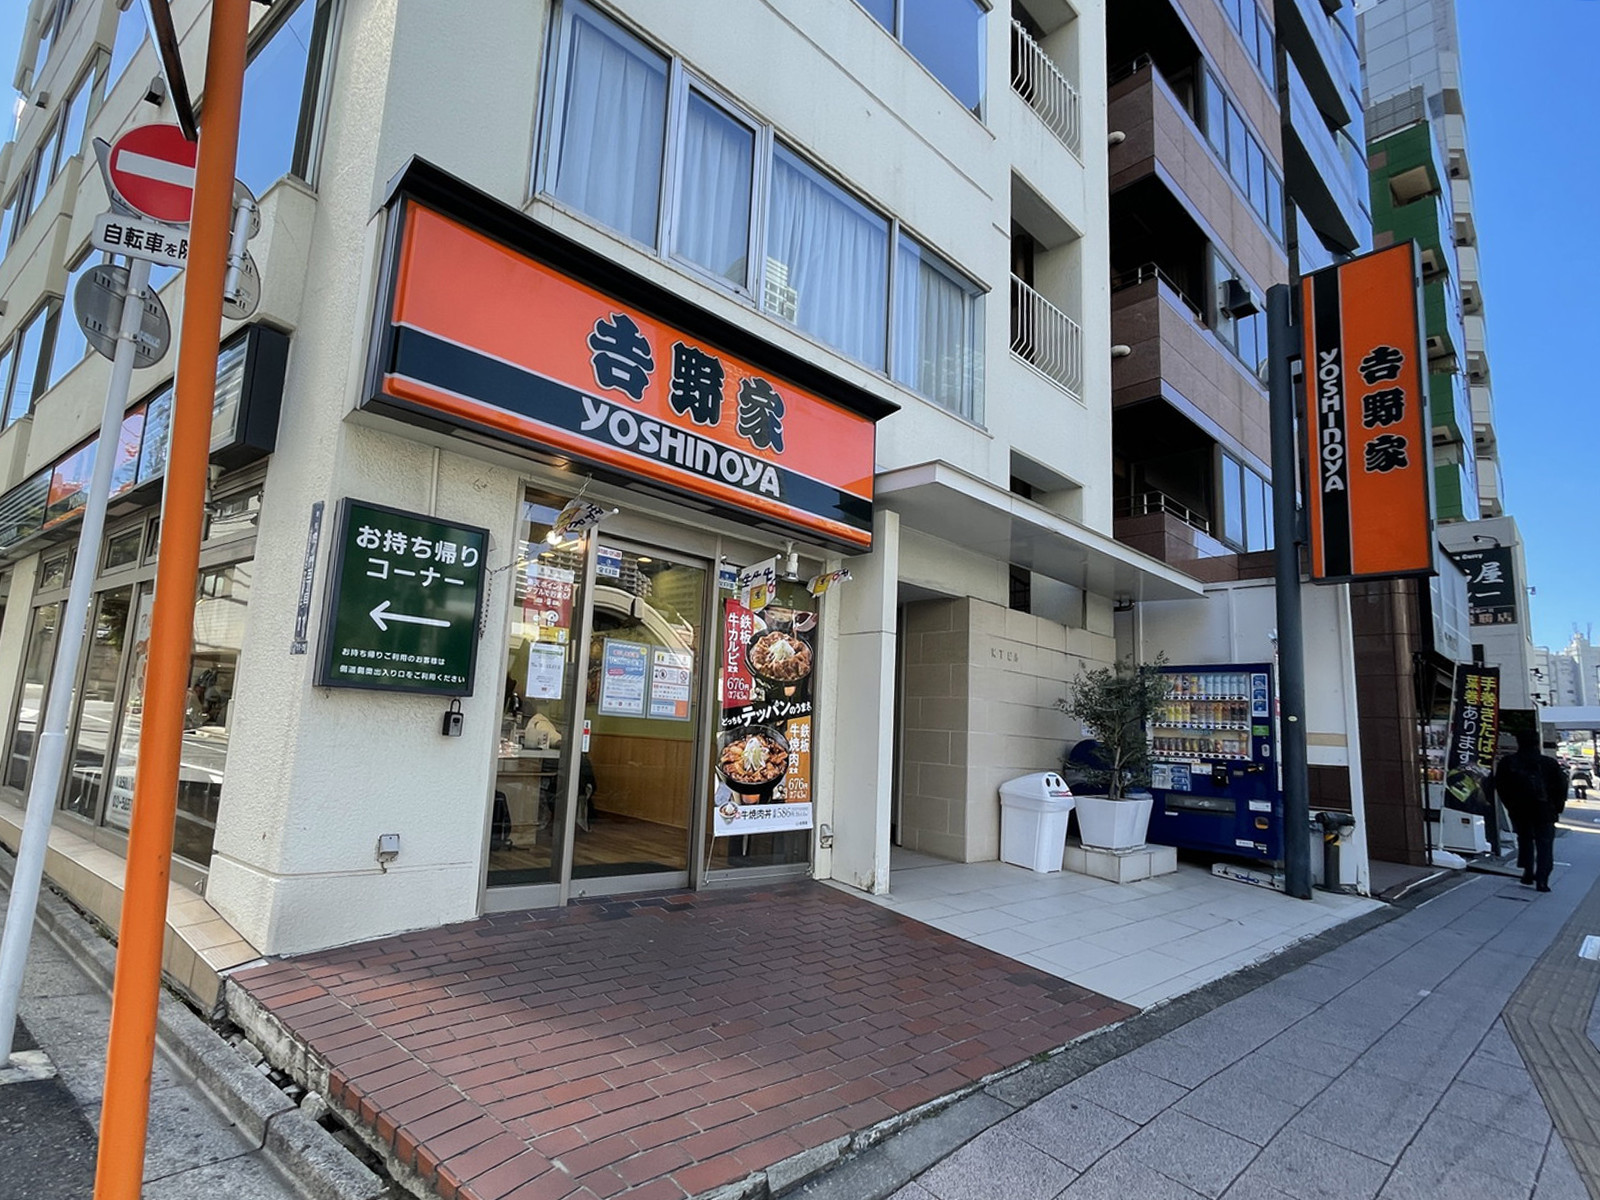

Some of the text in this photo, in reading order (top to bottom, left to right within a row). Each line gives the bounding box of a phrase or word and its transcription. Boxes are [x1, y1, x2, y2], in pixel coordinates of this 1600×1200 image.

[586, 311, 786, 454] 吉野家
[1319, 347, 1345, 493] YOSHINOYA
[1357, 345, 1410, 474] 吉野家
[580, 396, 781, 498] YOSHINOYA
[356, 525, 479, 568] お持ち帰り
[366, 557, 465, 587] コーナー
